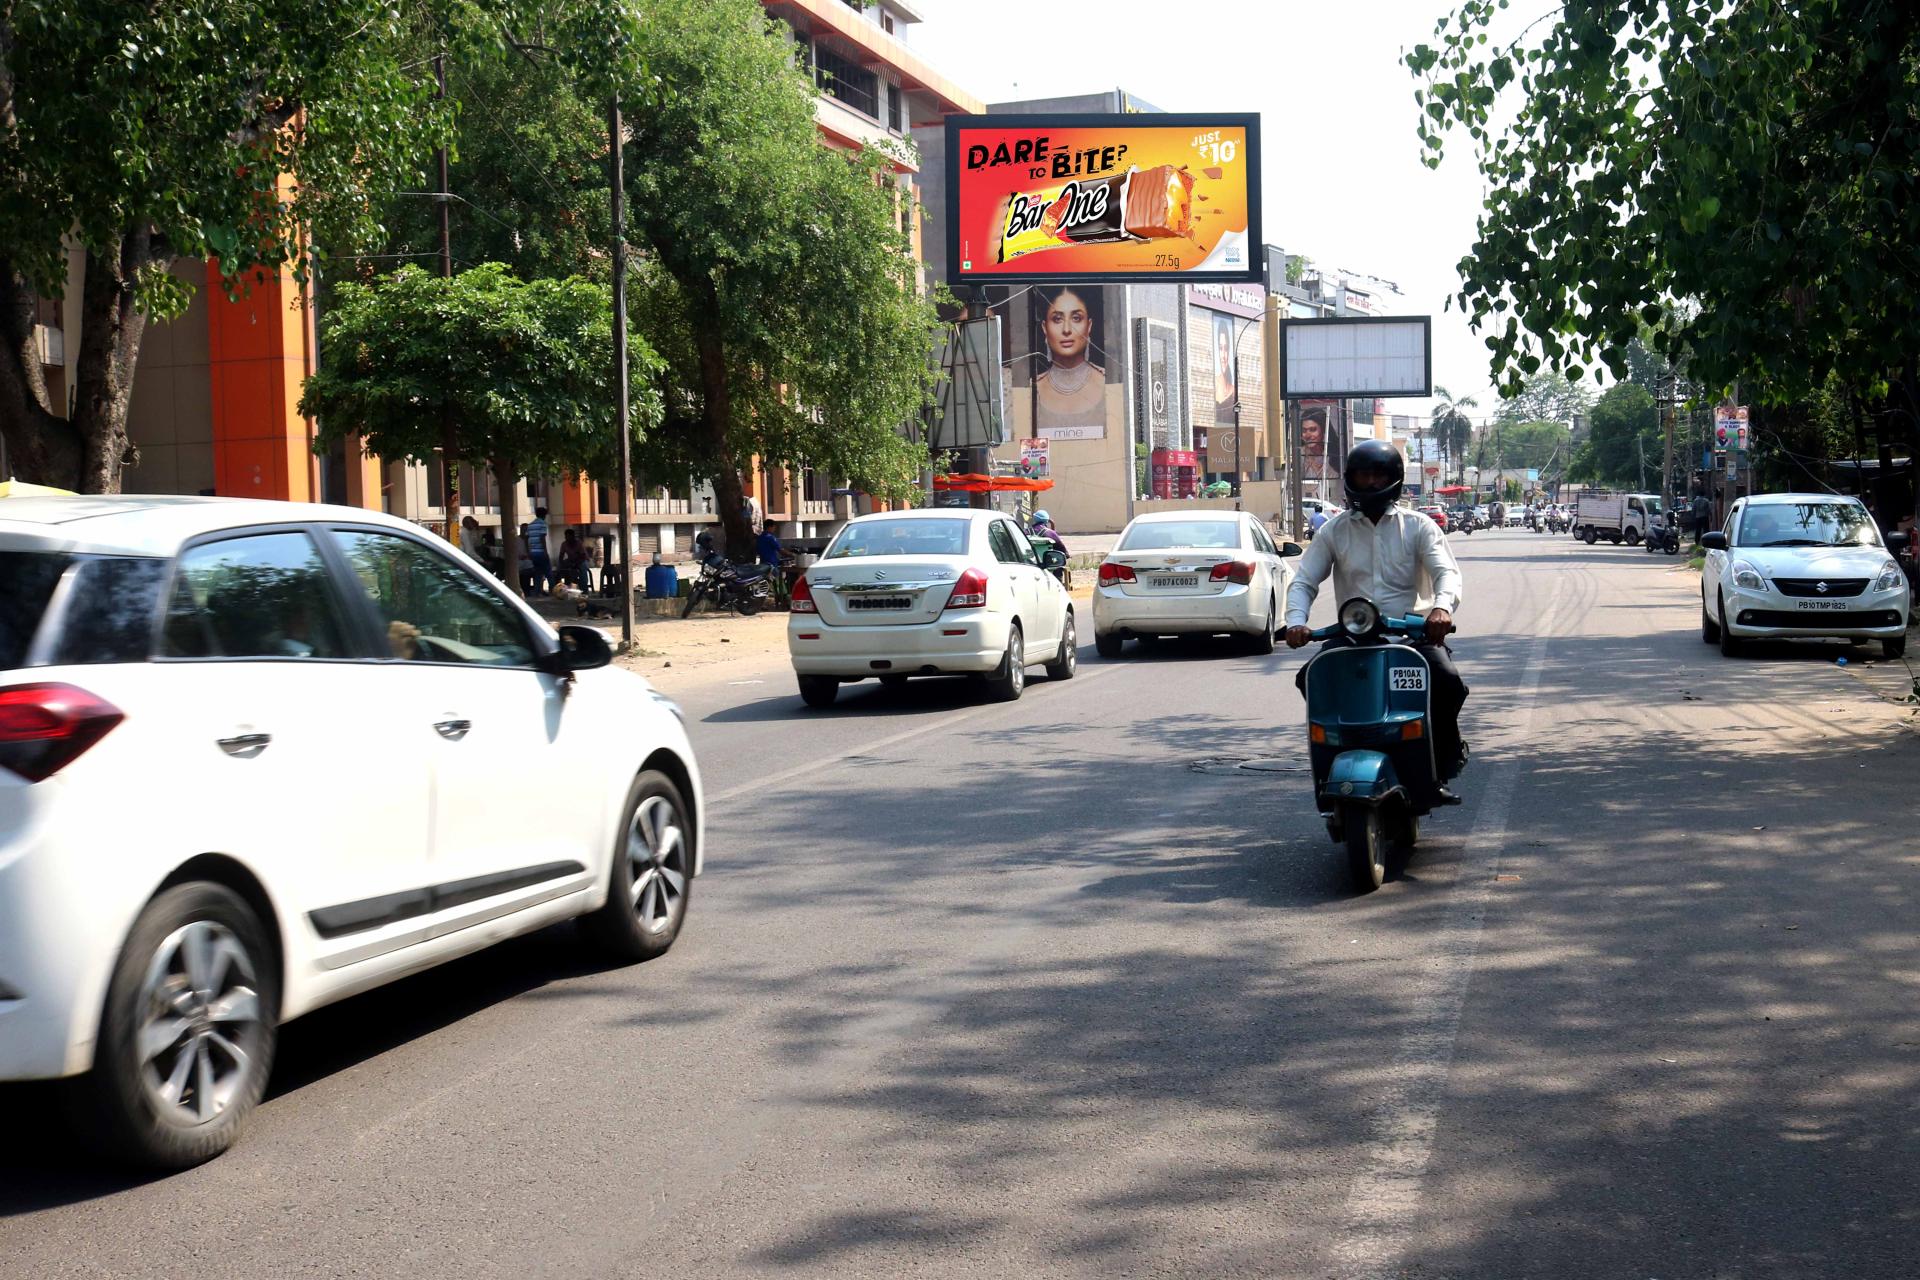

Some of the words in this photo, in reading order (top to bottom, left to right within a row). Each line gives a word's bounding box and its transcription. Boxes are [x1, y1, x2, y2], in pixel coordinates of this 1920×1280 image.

[1191, 131, 1220, 147] JUST
[967, 137, 1049, 170] DARE
[1028, 167, 1046, 179] TO
[1052, 144, 1128, 178] BITE?
[1006, 195, 1052, 239] Bar
[1055, 181, 1110, 233] One
[1155, 254, 1180, 269] 27.5g
[1393, 669, 1421, 678] PB10AX
[1393, 678, 1423, 689] 1238
